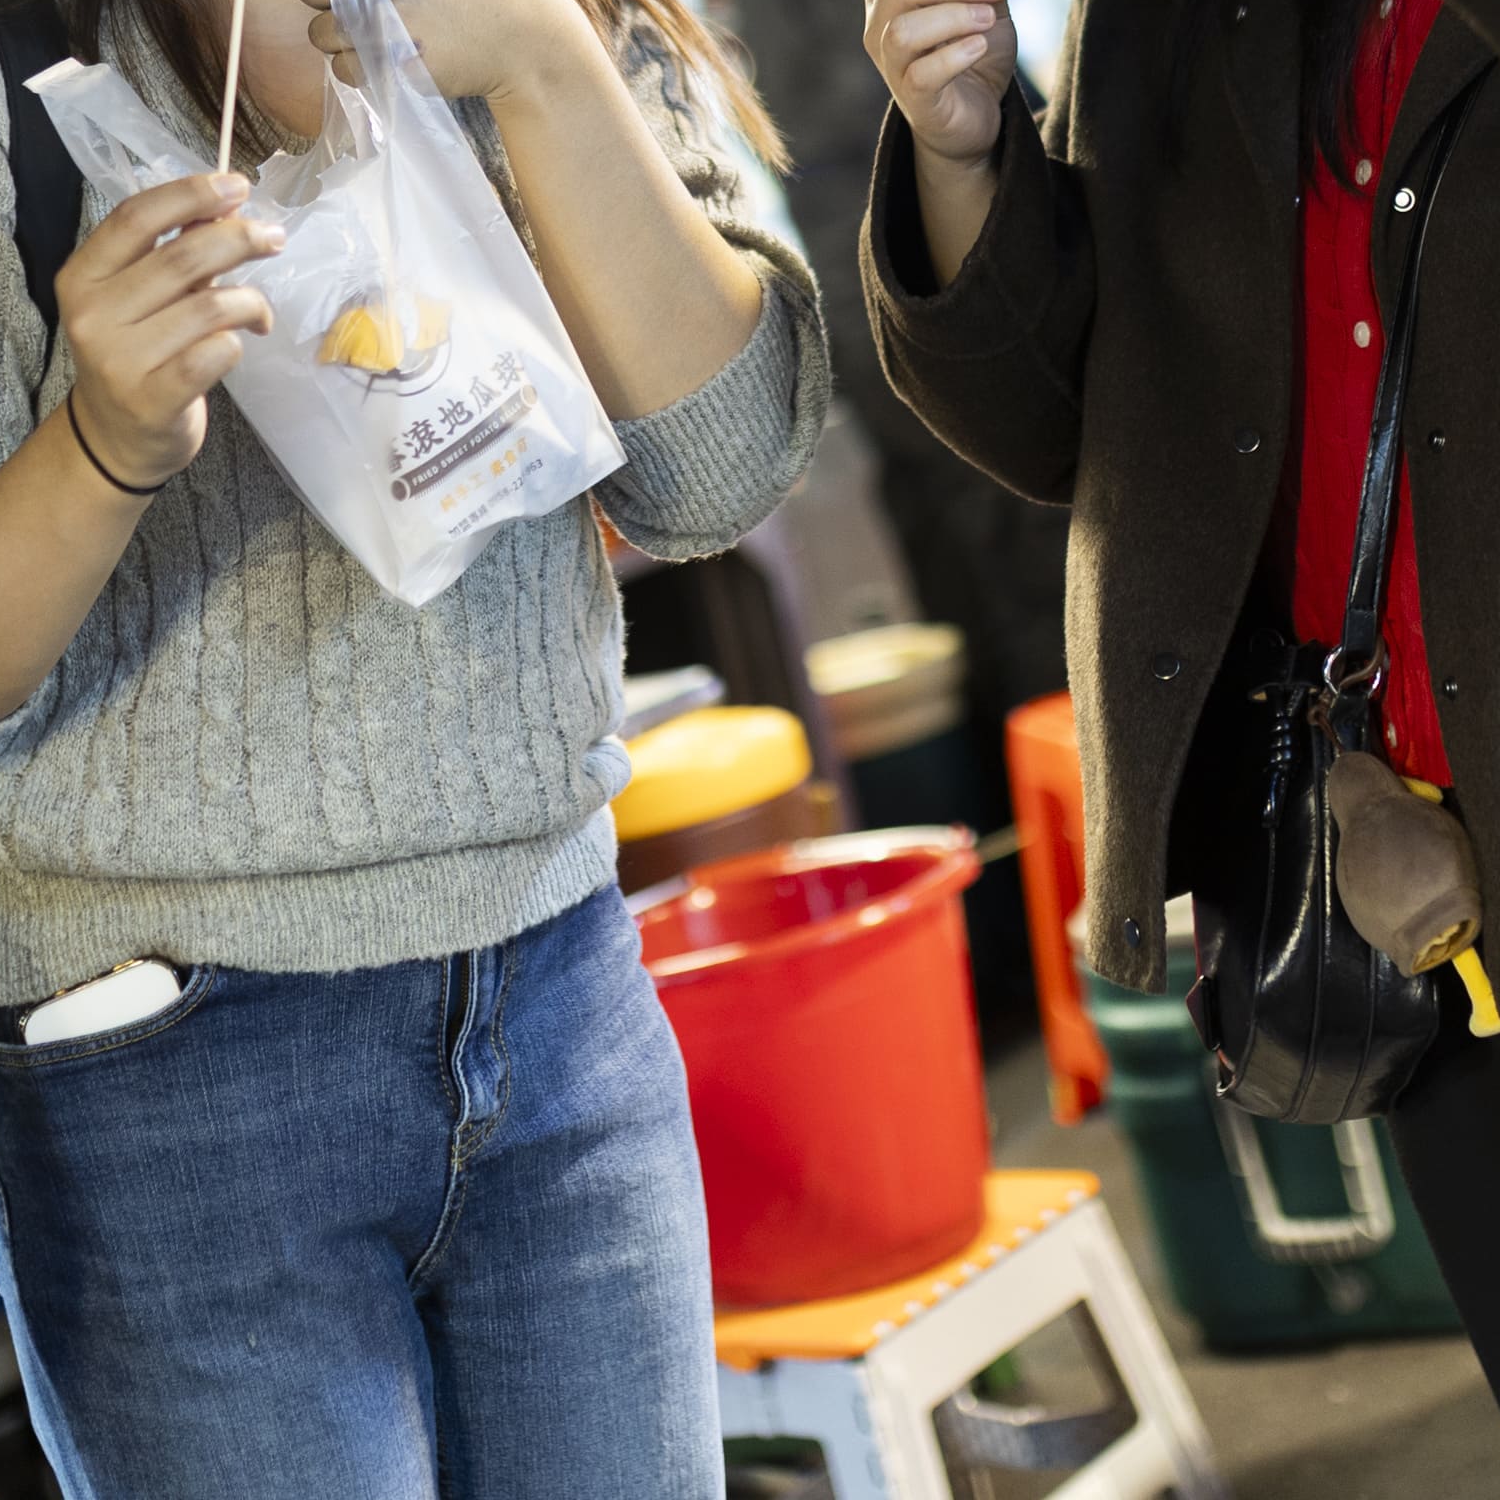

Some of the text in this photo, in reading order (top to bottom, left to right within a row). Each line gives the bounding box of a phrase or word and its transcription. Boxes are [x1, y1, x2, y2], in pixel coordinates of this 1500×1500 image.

[412, 463, 439, 486] FRIED
[441, 443, 469, 469] SWEET
[470, 421, 499, 447] POTATO
